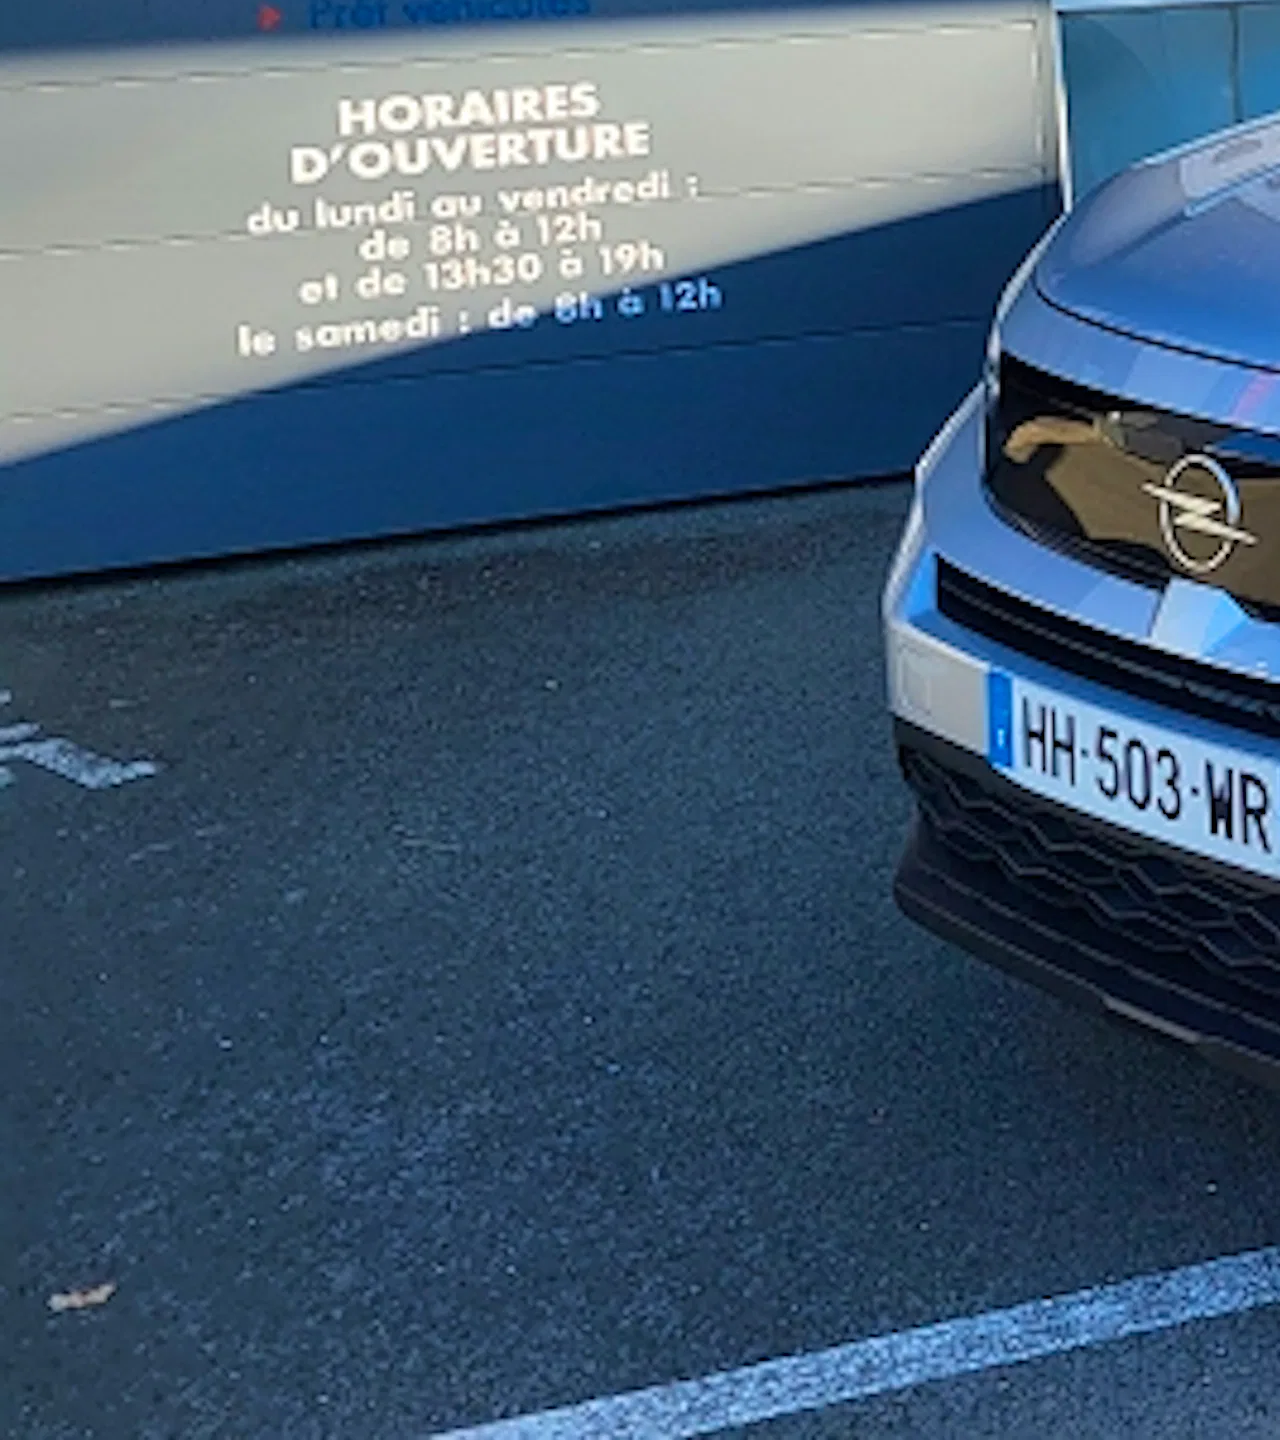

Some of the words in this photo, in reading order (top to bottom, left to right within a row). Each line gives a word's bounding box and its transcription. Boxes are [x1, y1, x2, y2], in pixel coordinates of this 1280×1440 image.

[337, 83, 601, 136] HORAIRES
[289, 122, 650, 185] D'OUVERTURE
[247, 201, 299, 235] du
[315, 191, 416, 231] lundi
[431, 196, 482, 221] au
[500, 170, 670, 212] vendredi
[358, 230, 410, 264] de
[429, 222, 479, 254] 8h
[496, 218, 522, 250] à
[537, 211, 603, 247] 12h
[299, 274, 338, 306] et
[355, 264, 407, 300] de
[423, 251, 541, 293] 13h30
[559, 246, 584, 278] à
[600, 241, 665, 275] 19h
[237, 325, 276, 358] le
[295, 304, 440, 352] samedi
[488, 296, 539, 332] de
[554, 291, 603, 324] 8h
[617, 283, 644, 317] à
[659, 277, 722, 312] 12h
[1021, 696, 1272, 854] HH-503-WR
